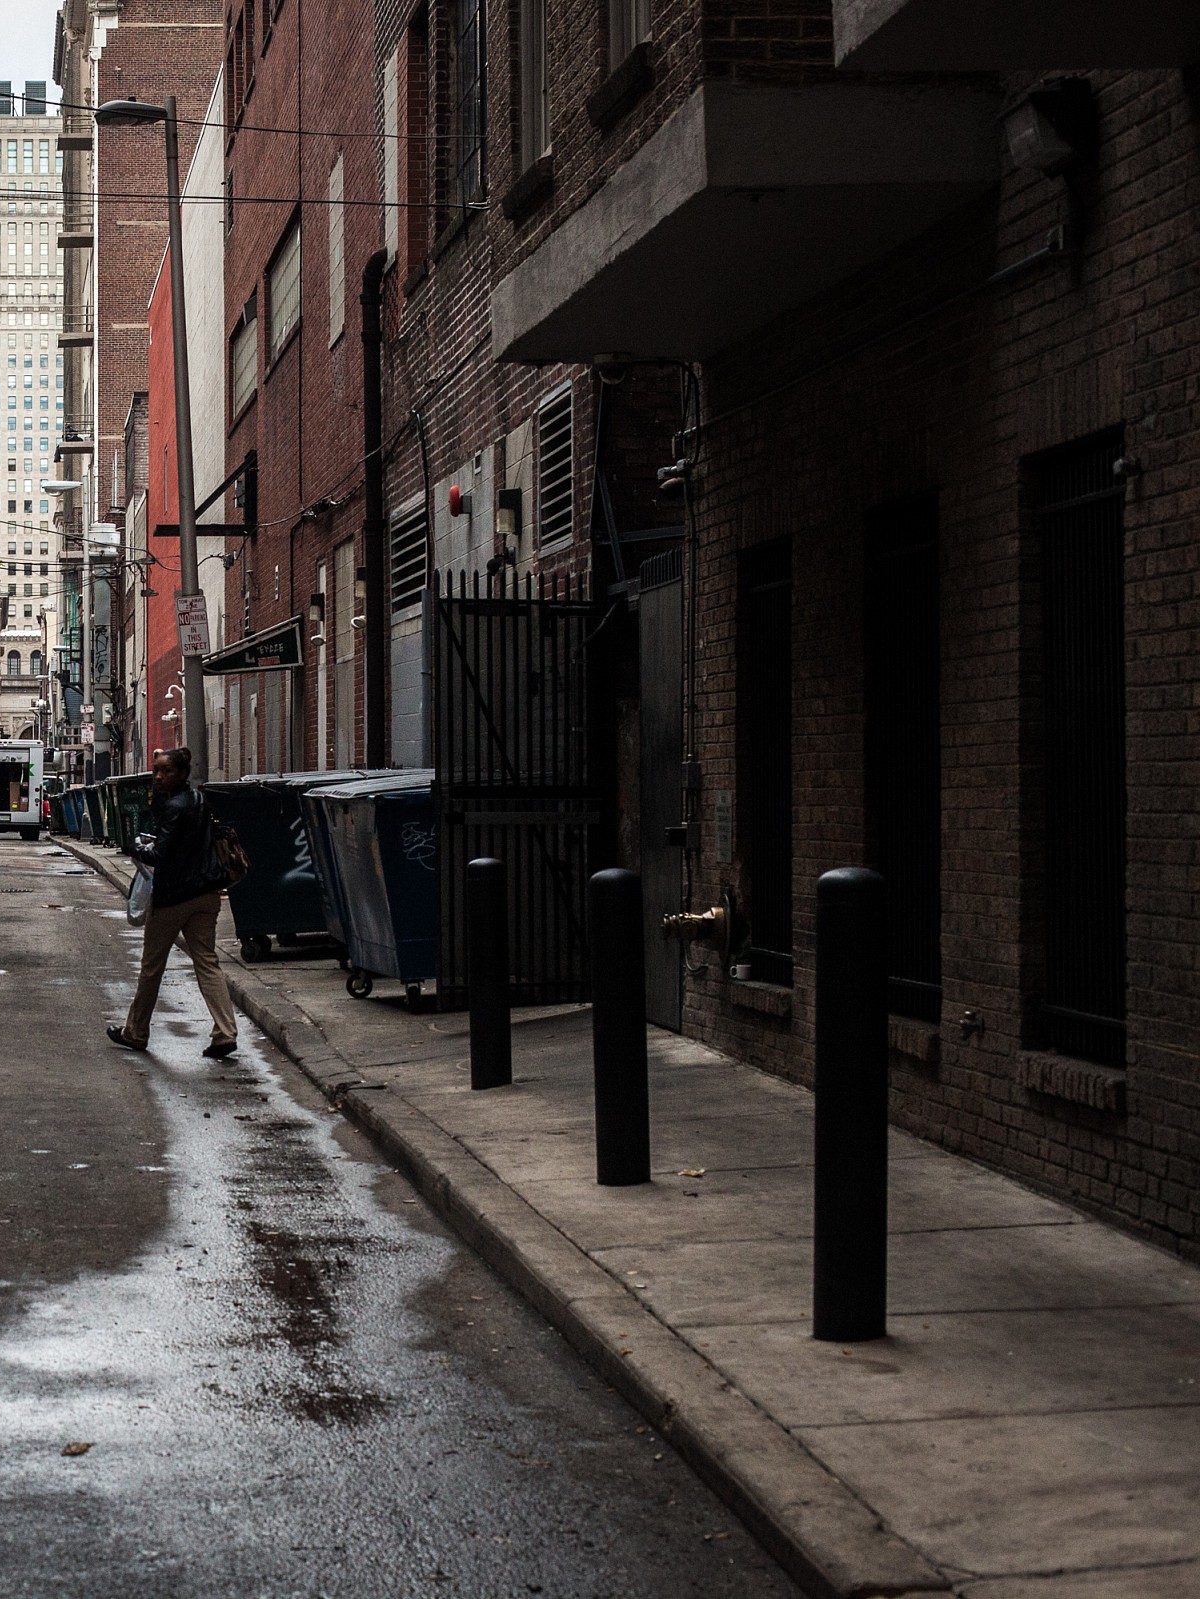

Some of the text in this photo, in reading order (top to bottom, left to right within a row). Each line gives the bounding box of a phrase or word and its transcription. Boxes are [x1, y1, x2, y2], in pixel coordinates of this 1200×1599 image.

[179, 614, 190, 625] NO
[187, 634, 201, 642] THIS
[184, 642, 207, 651] STREET
